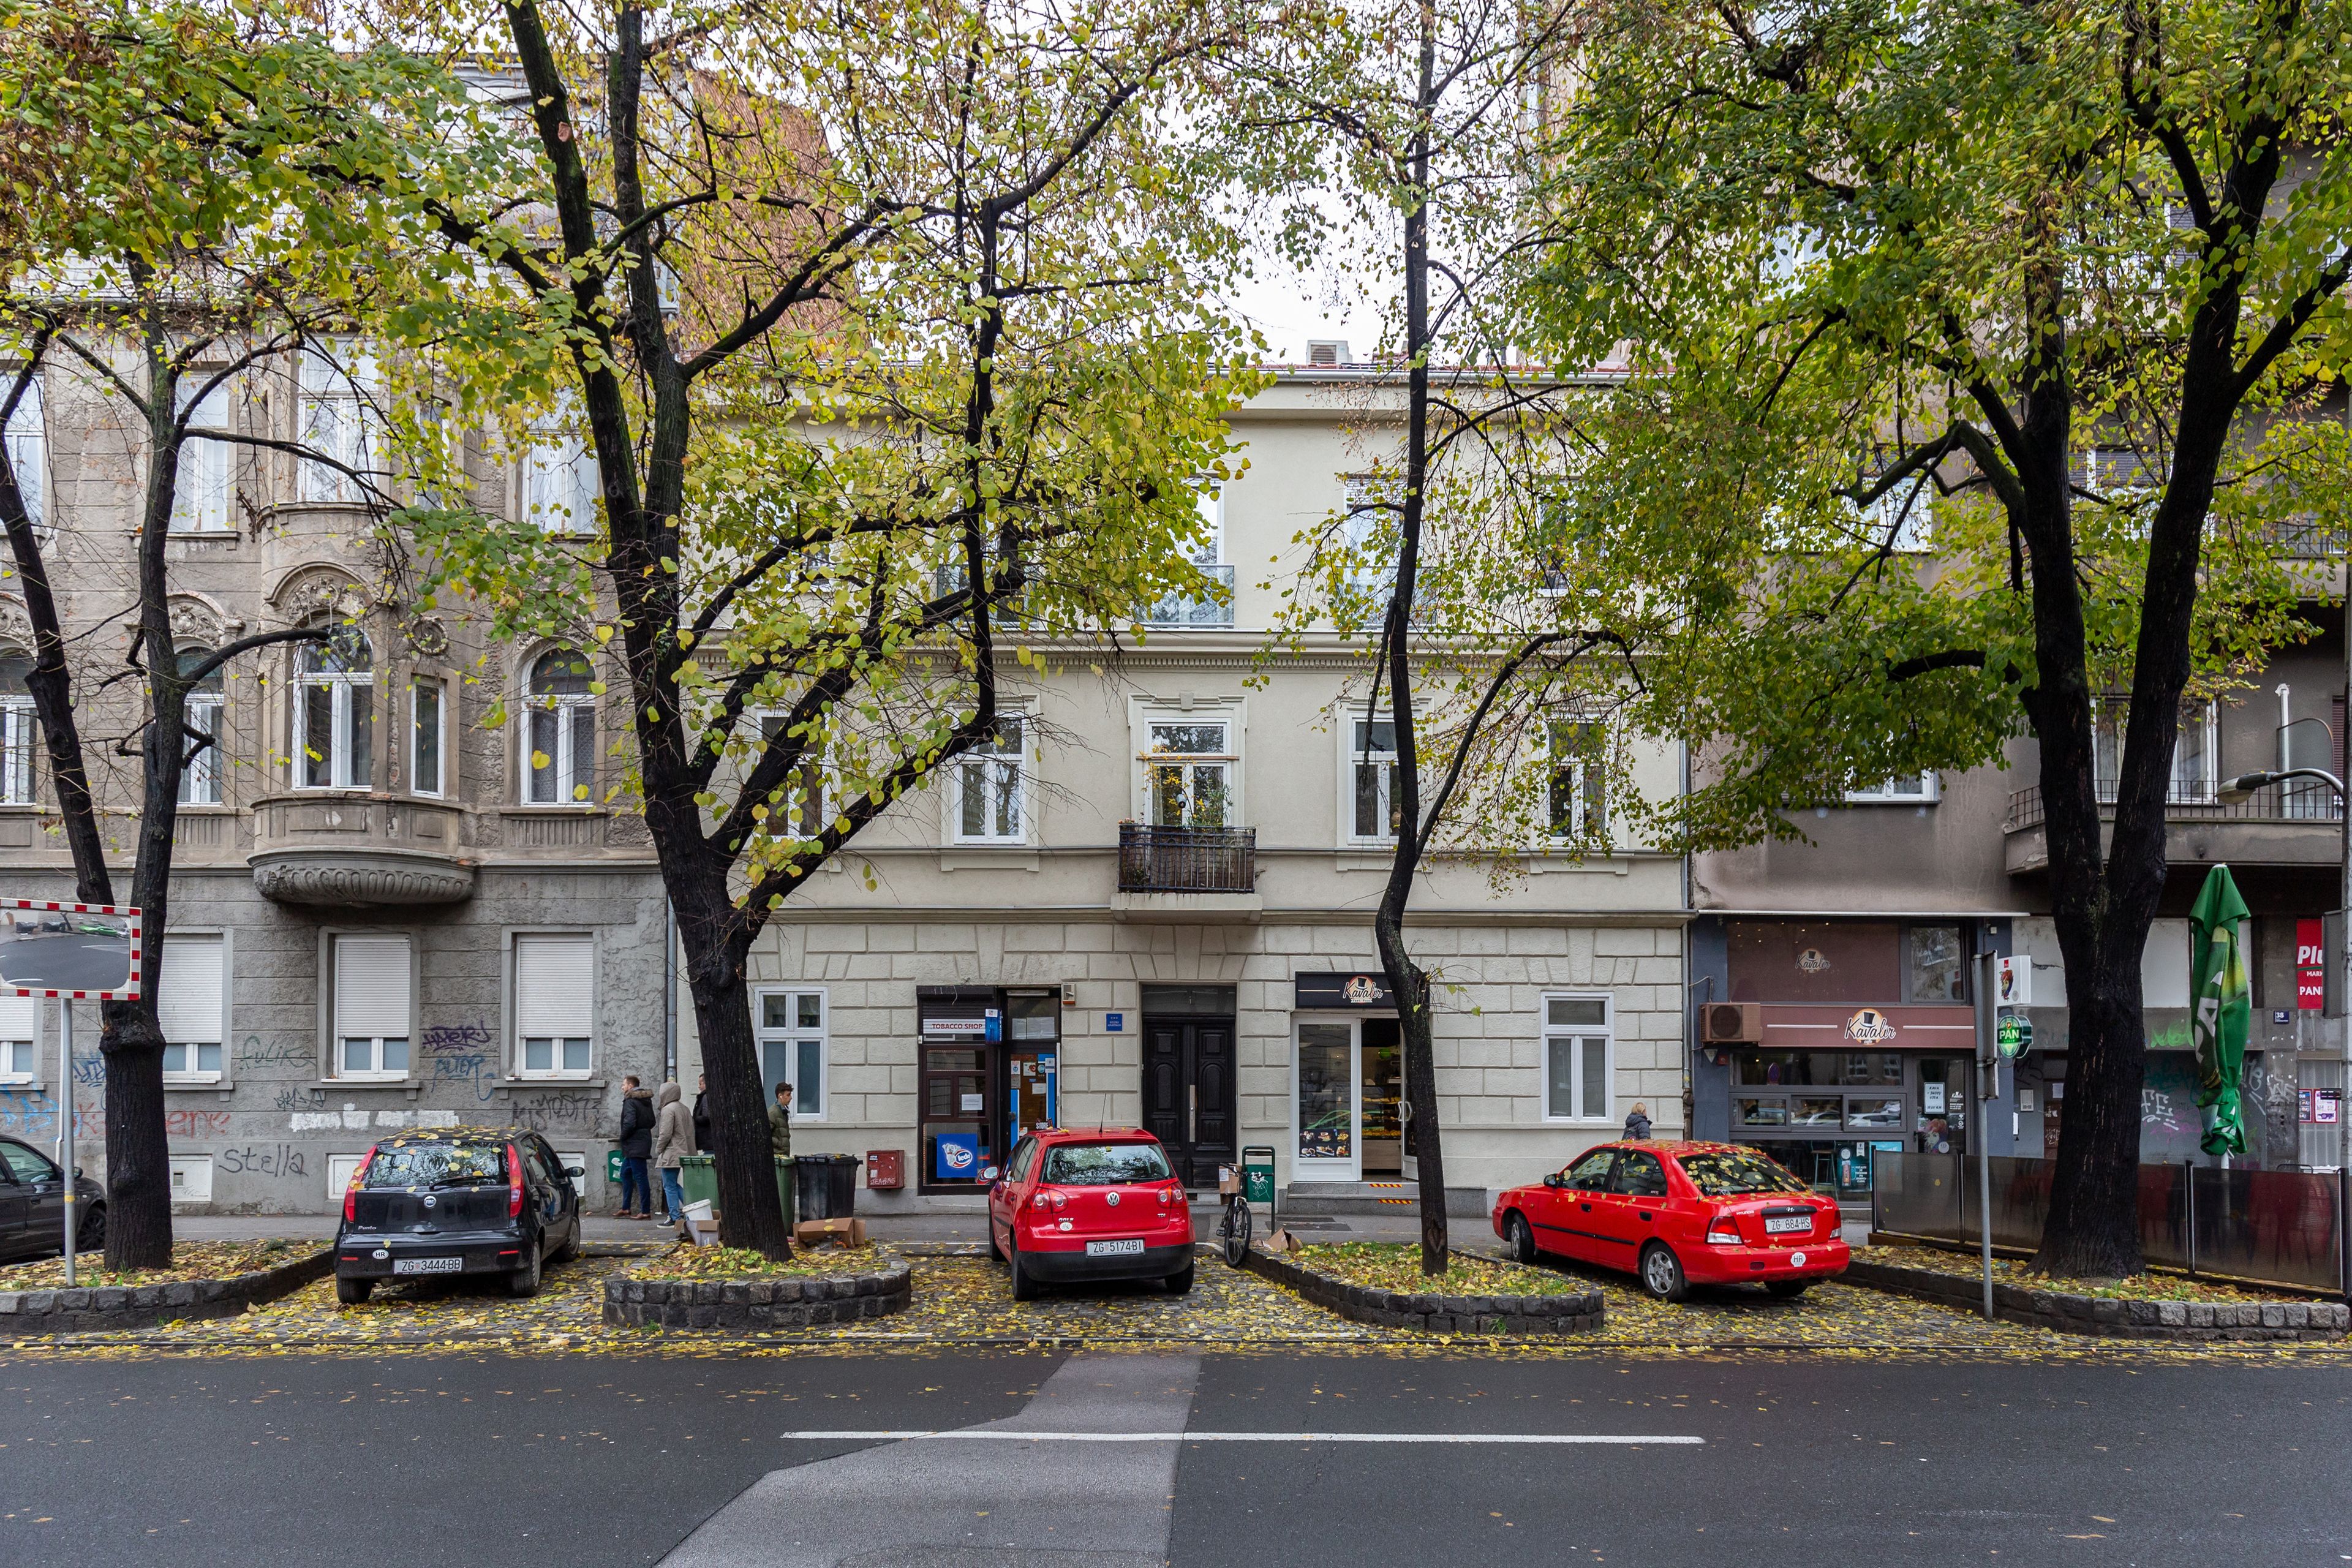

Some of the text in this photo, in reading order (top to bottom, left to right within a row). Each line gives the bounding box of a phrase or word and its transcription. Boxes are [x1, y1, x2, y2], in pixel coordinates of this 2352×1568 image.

[2299, 986, 2323, 995] PAN
[1999, 1029, 2019, 1039] PAN
[1771, 1220, 1781, 1230] ZG
[1093, 1242, 1104, 1253] ZG
[402, 1261, 414, 1271] ZG
